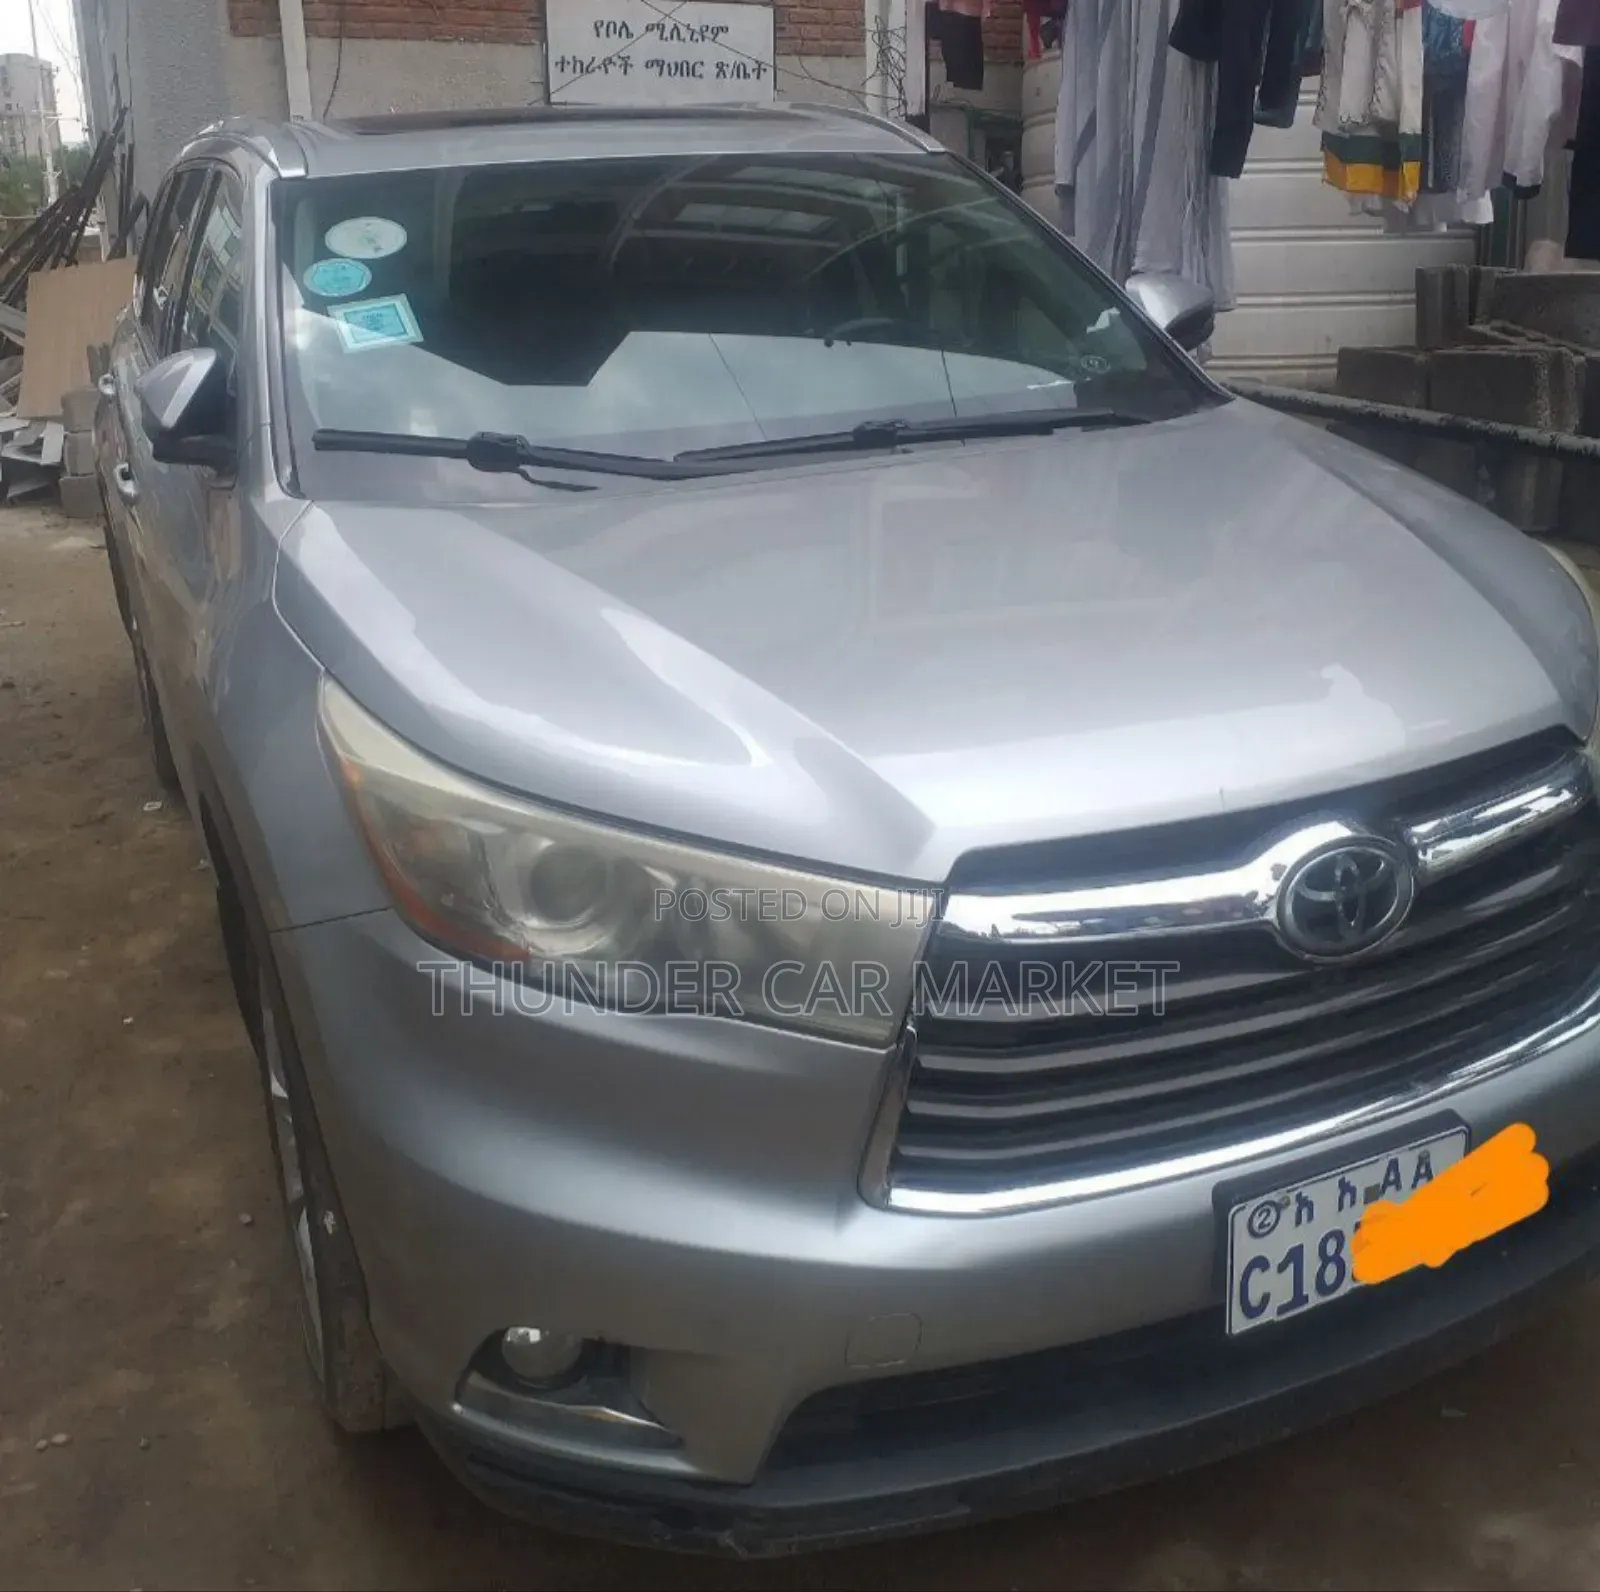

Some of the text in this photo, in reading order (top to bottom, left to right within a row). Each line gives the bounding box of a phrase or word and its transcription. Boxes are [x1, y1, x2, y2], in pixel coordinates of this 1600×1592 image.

[593, 19, 634, 39] የቦሌ
[644, 58, 704, 79] ማህበር
[1239, 1221, 1360, 1320] C18
